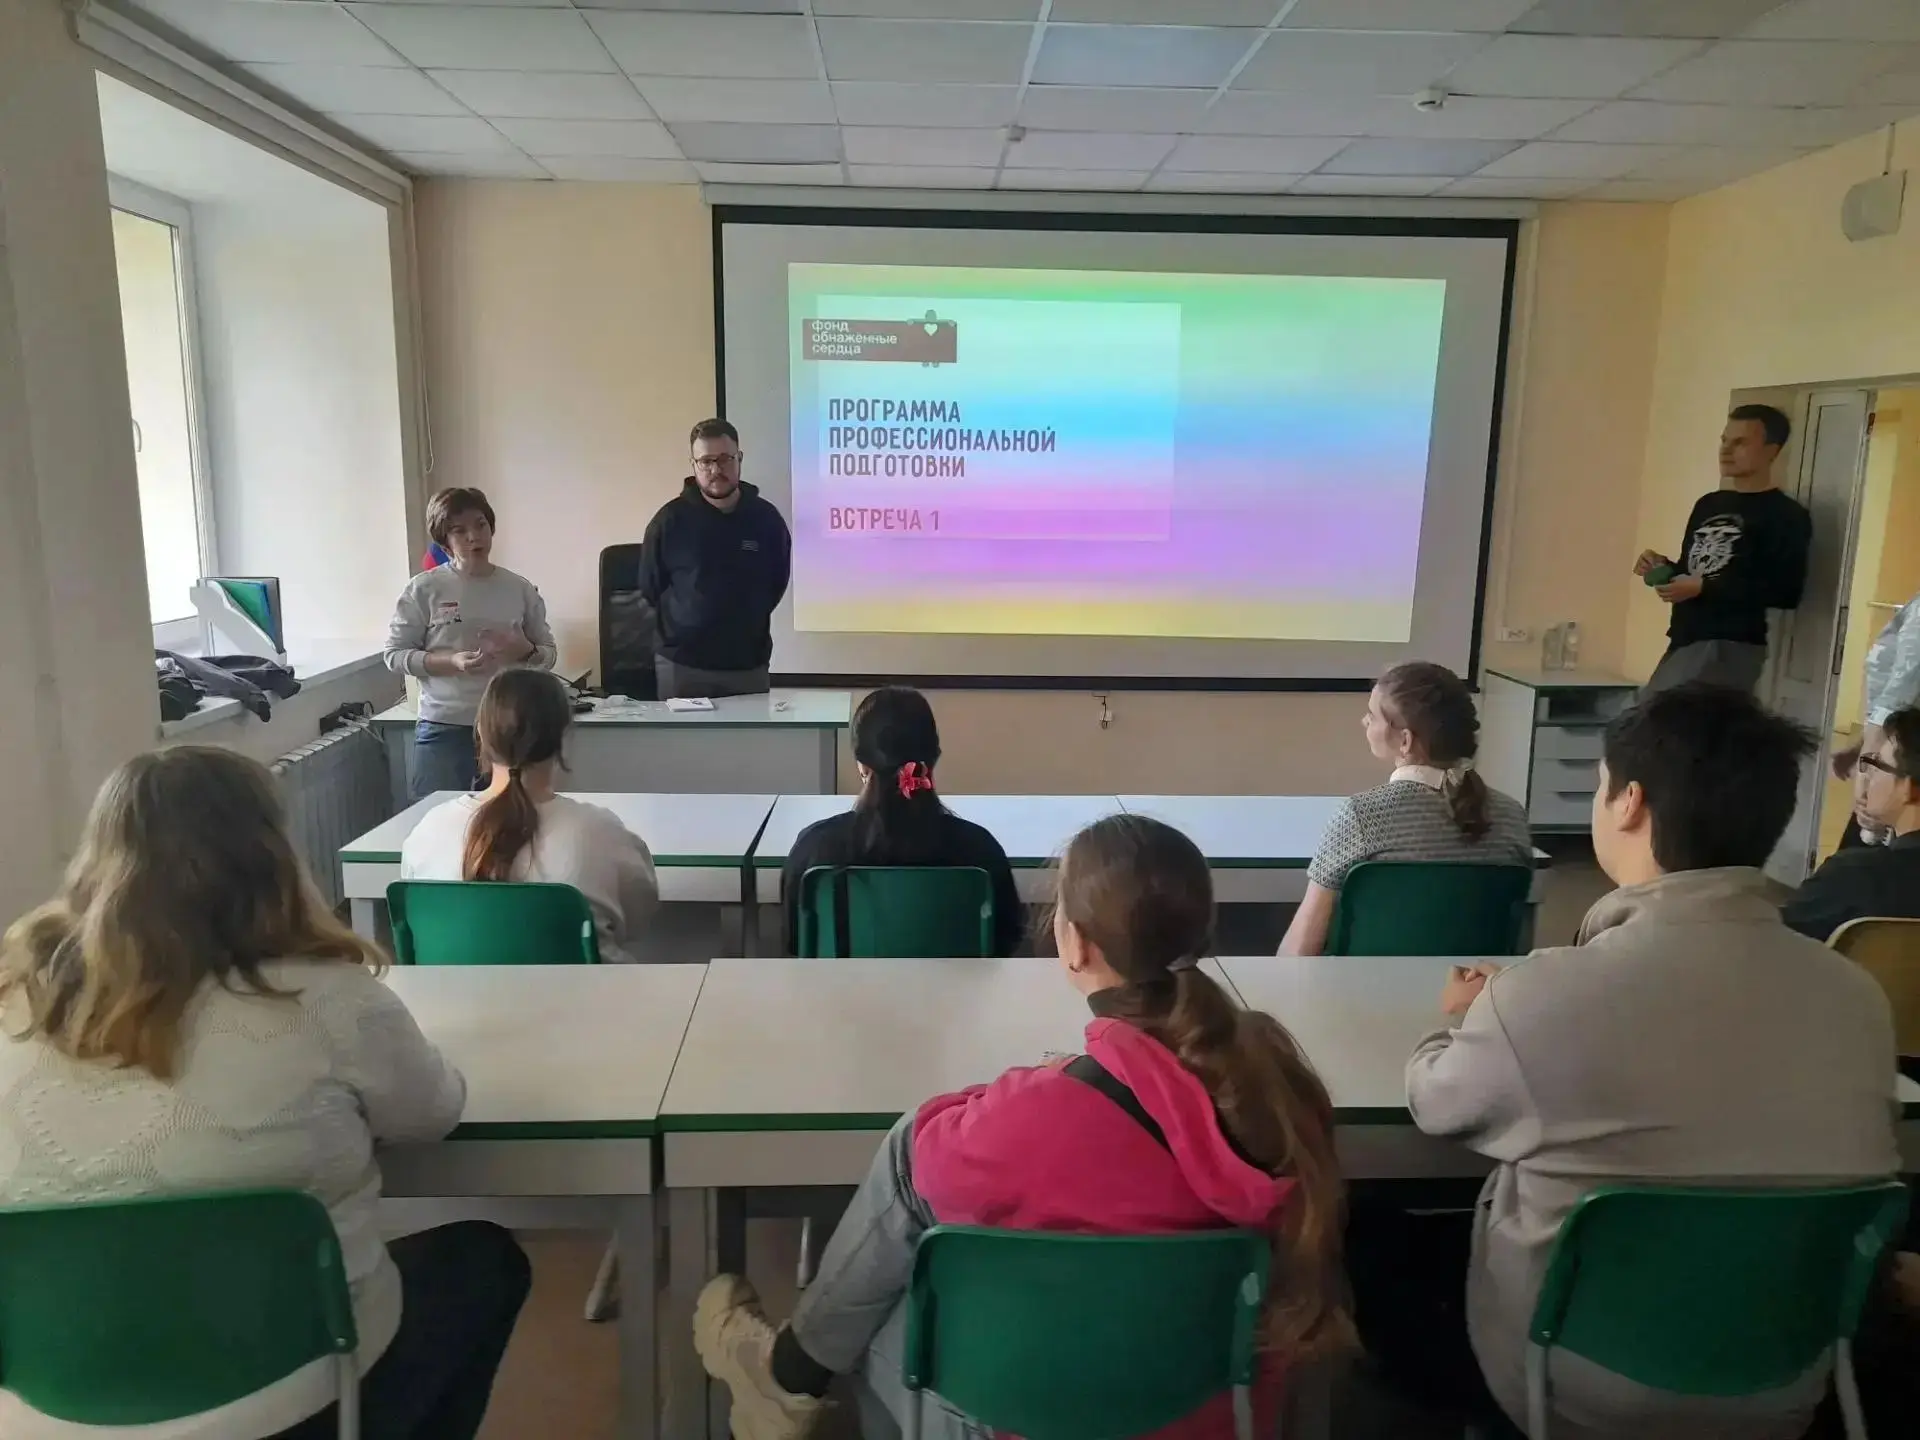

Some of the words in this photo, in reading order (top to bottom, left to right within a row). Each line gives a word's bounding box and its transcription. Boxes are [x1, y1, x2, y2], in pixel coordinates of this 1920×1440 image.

[811, 319, 849, 333] фонд
[811, 343, 862, 356] сердца
[828, 398, 961, 423] ПРОГРАММА
[829, 425, 1056, 453] ПРОФЕССИОНАЛЬНОЙ
[829, 453, 965, 477] ПОДГОТОВКИ
[829, 507, 922, 530] ВСТРЕЧА
[930, 510, 940, 531] 1
